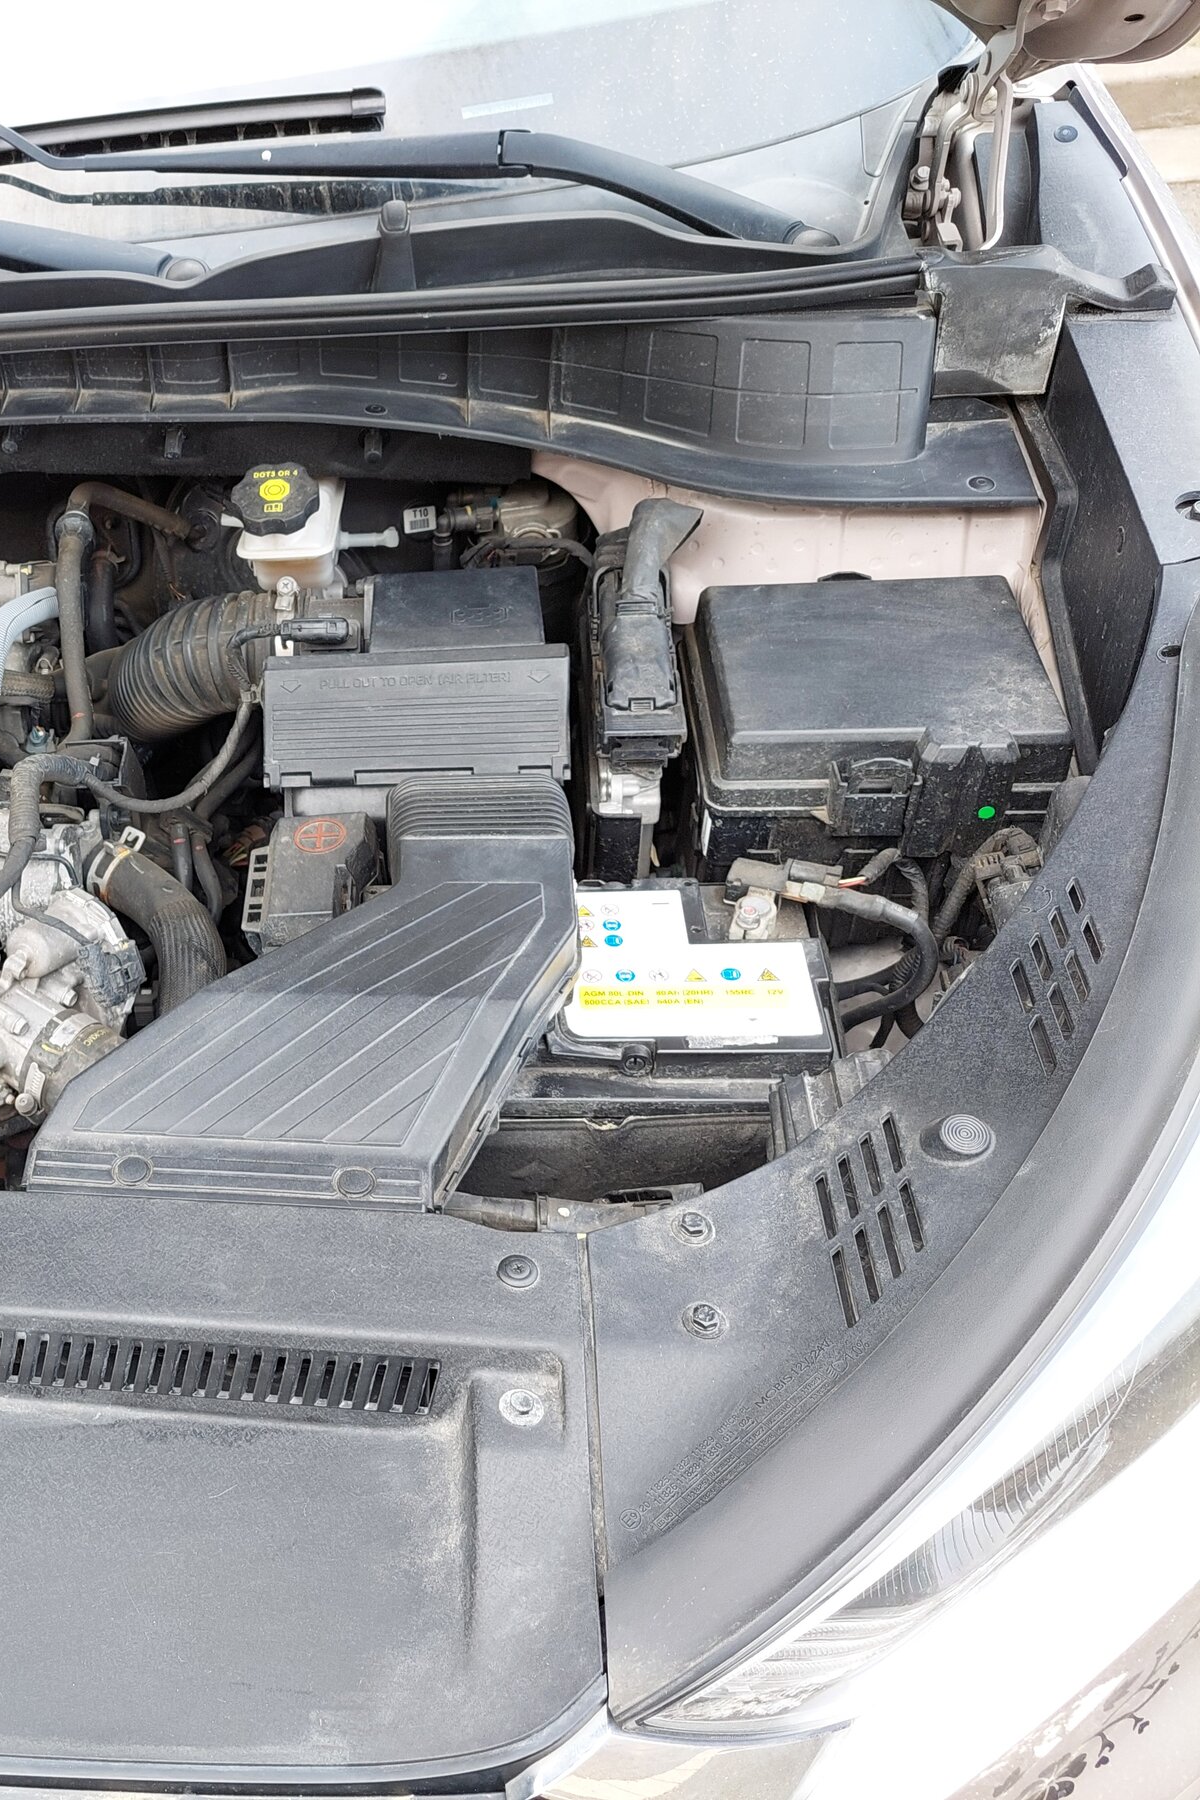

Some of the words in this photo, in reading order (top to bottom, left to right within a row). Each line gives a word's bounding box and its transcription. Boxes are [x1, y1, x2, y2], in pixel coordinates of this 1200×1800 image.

[253, 470, 276, 479] DOT3
[277, 469, 290, 477] OR
[412, 508, 429, 519] T10
[319, 678, 350, 690] PULL
[352, 677, 377, 688] OUT
[380, 676, 397, 687] TO
[400, 674, 433, 687] OPEN
[754, 1372, 793, 1409] MOBIS
